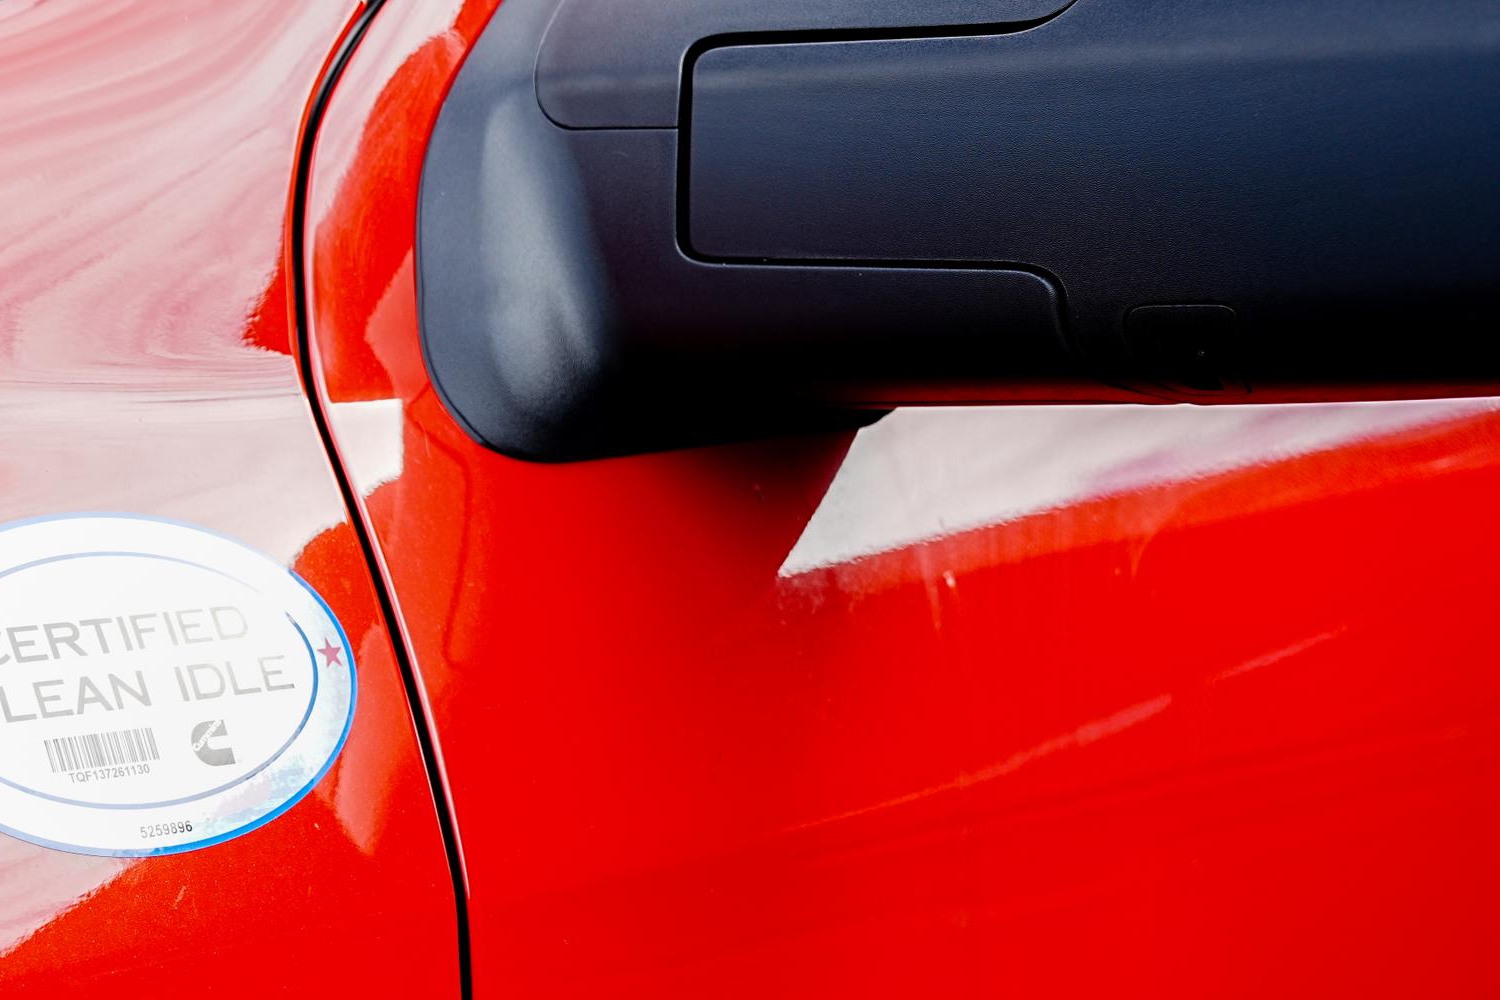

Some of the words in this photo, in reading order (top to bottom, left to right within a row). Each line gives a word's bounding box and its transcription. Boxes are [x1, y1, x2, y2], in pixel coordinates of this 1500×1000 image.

[173, 654, 296, 704] IDLE
[68, 763, 151, 784] TQF137261130
[140, 820, 193, 839] 5259896
